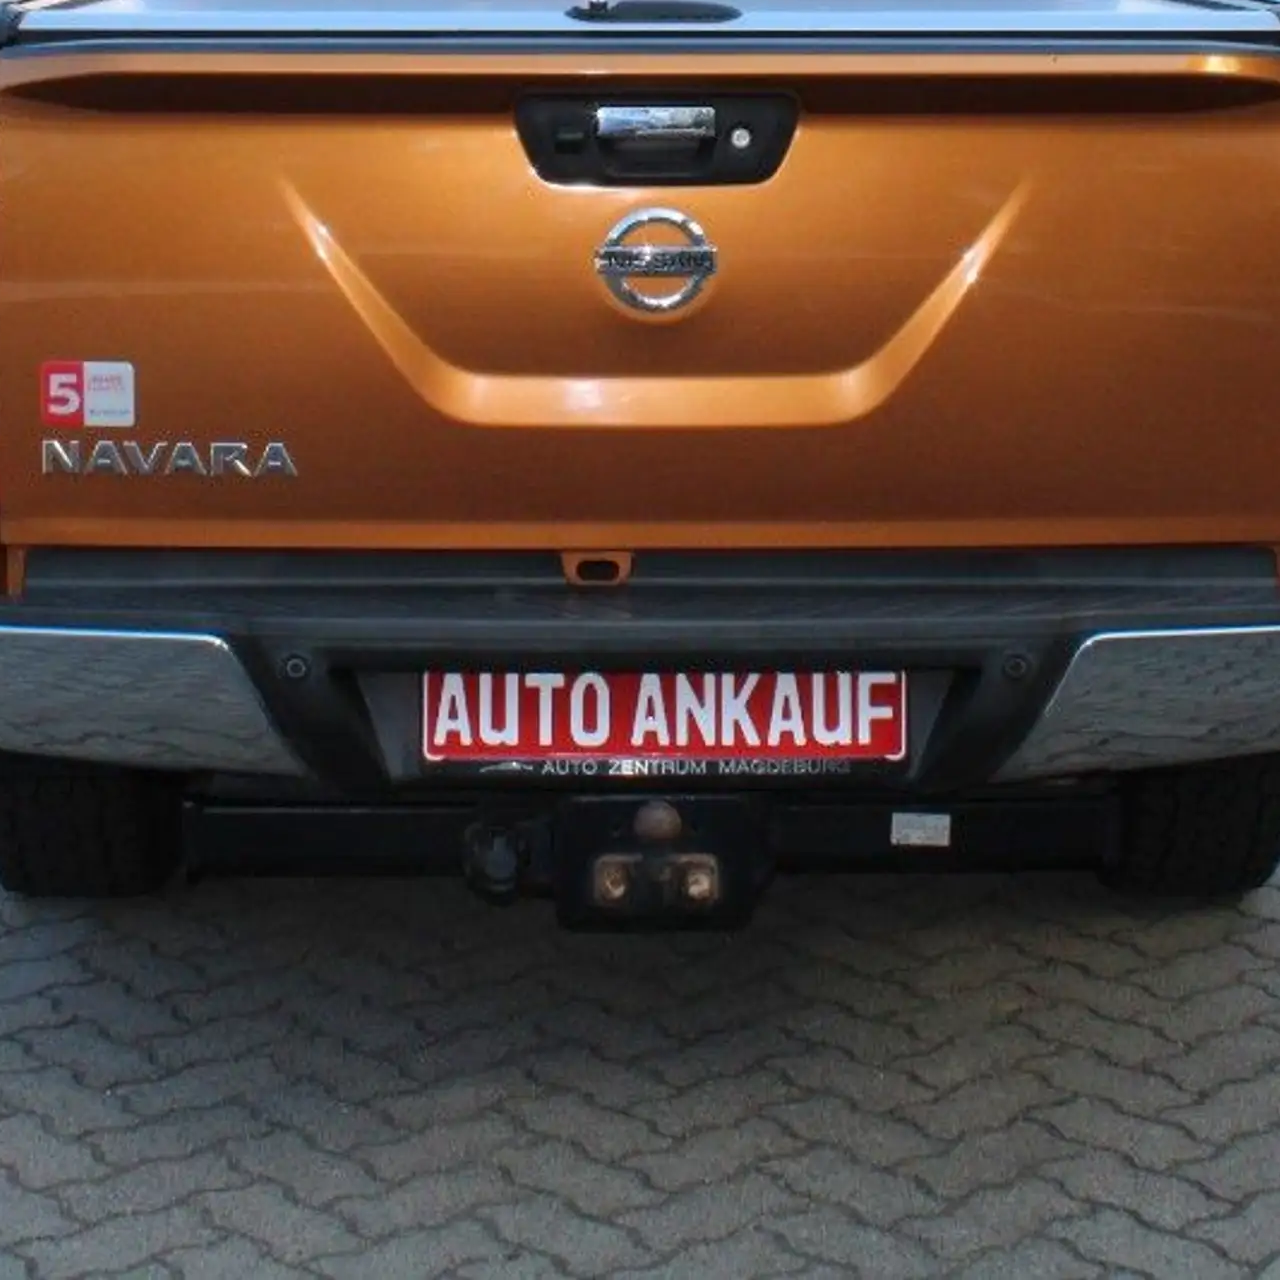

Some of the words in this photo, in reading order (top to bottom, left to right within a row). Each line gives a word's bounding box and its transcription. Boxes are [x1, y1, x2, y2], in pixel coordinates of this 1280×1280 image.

[48, 373, 81, 416] 5
[42, 440, 298, 477] NAVARA
[434, 673, 610, 747] AUTO
[630, 672, 896, 747] ANKAUF
[541, 761, 598, 776] AUTO
[608, 761, 706, 776] ZENTRUM
[718, 761, 851, 776] MAGDEBURG
